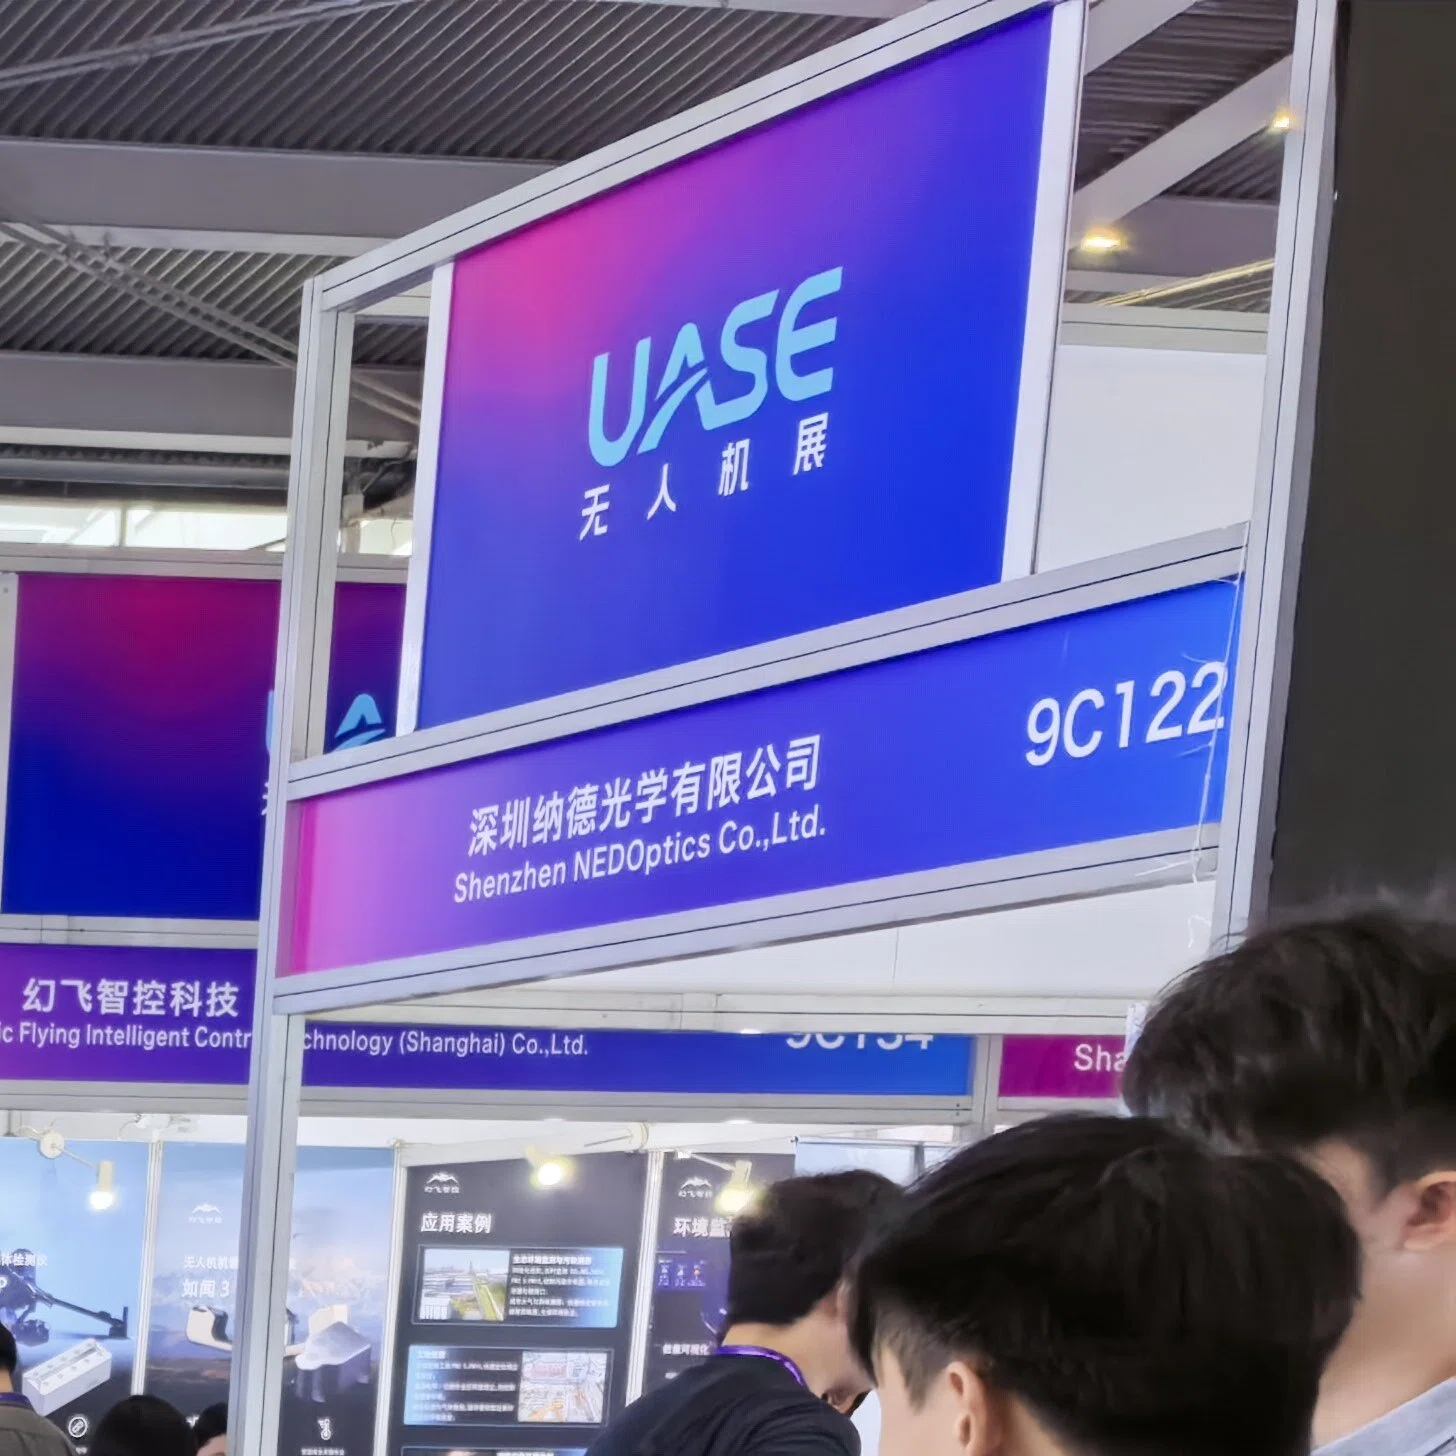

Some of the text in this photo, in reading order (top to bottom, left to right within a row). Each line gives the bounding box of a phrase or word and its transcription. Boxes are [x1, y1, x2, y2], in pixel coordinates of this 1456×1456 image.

[588, 266, 843, 468] UASE
[577, 413, 829, 542] 无人机展
[1026, 660, 1227, 768] 9C122
[467, 734, 822, 858] 深圳纳德光学有限公司
[454, 804, 827, 905] Shenzhen NEDOptics Co.,Ltd.
[19, 1021, 80, 1048] Flying
[86, 1023, 190, 1051] Intelligent
[195, 1025, 252, 1049] Contr
[303, 1029, 393, 1055] chnology
[399, 1030, 506, 1057] (Shanghai)
[512, 1032, 589, 1057] Co.,Ltd.
[22, 977, 240, 1018] 幻飞智控科技
[420, 1211, 492, 1234] 应用案例
[673, 1217, 733, 1238] 环境监
